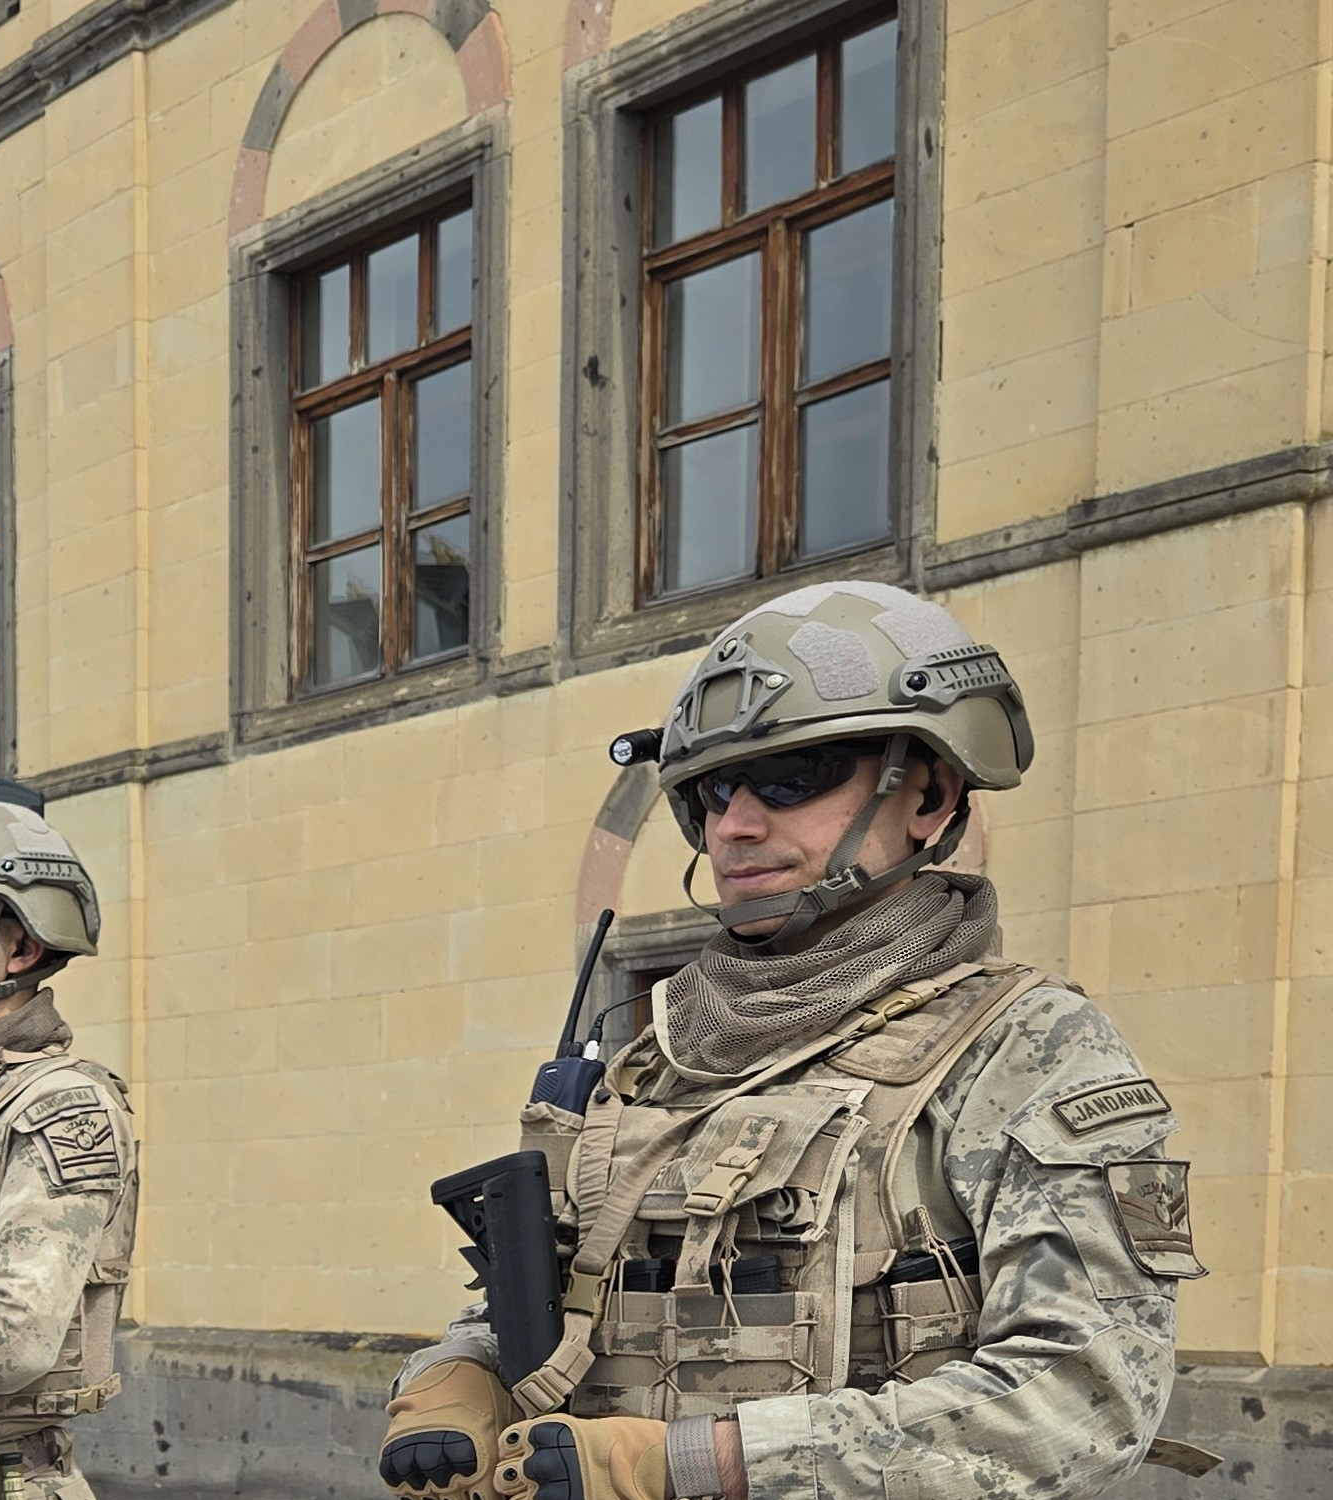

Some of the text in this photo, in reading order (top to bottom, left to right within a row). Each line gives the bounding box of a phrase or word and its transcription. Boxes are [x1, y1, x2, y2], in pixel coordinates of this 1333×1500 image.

[34, 1089, 93, 1116] JANDARMA
[1075, 1087, 1159, 1122] JANDARMA
[61, 1118, 98, 1134] UZMAN
[1137, 1180, 1175, 1200] UZMAN
